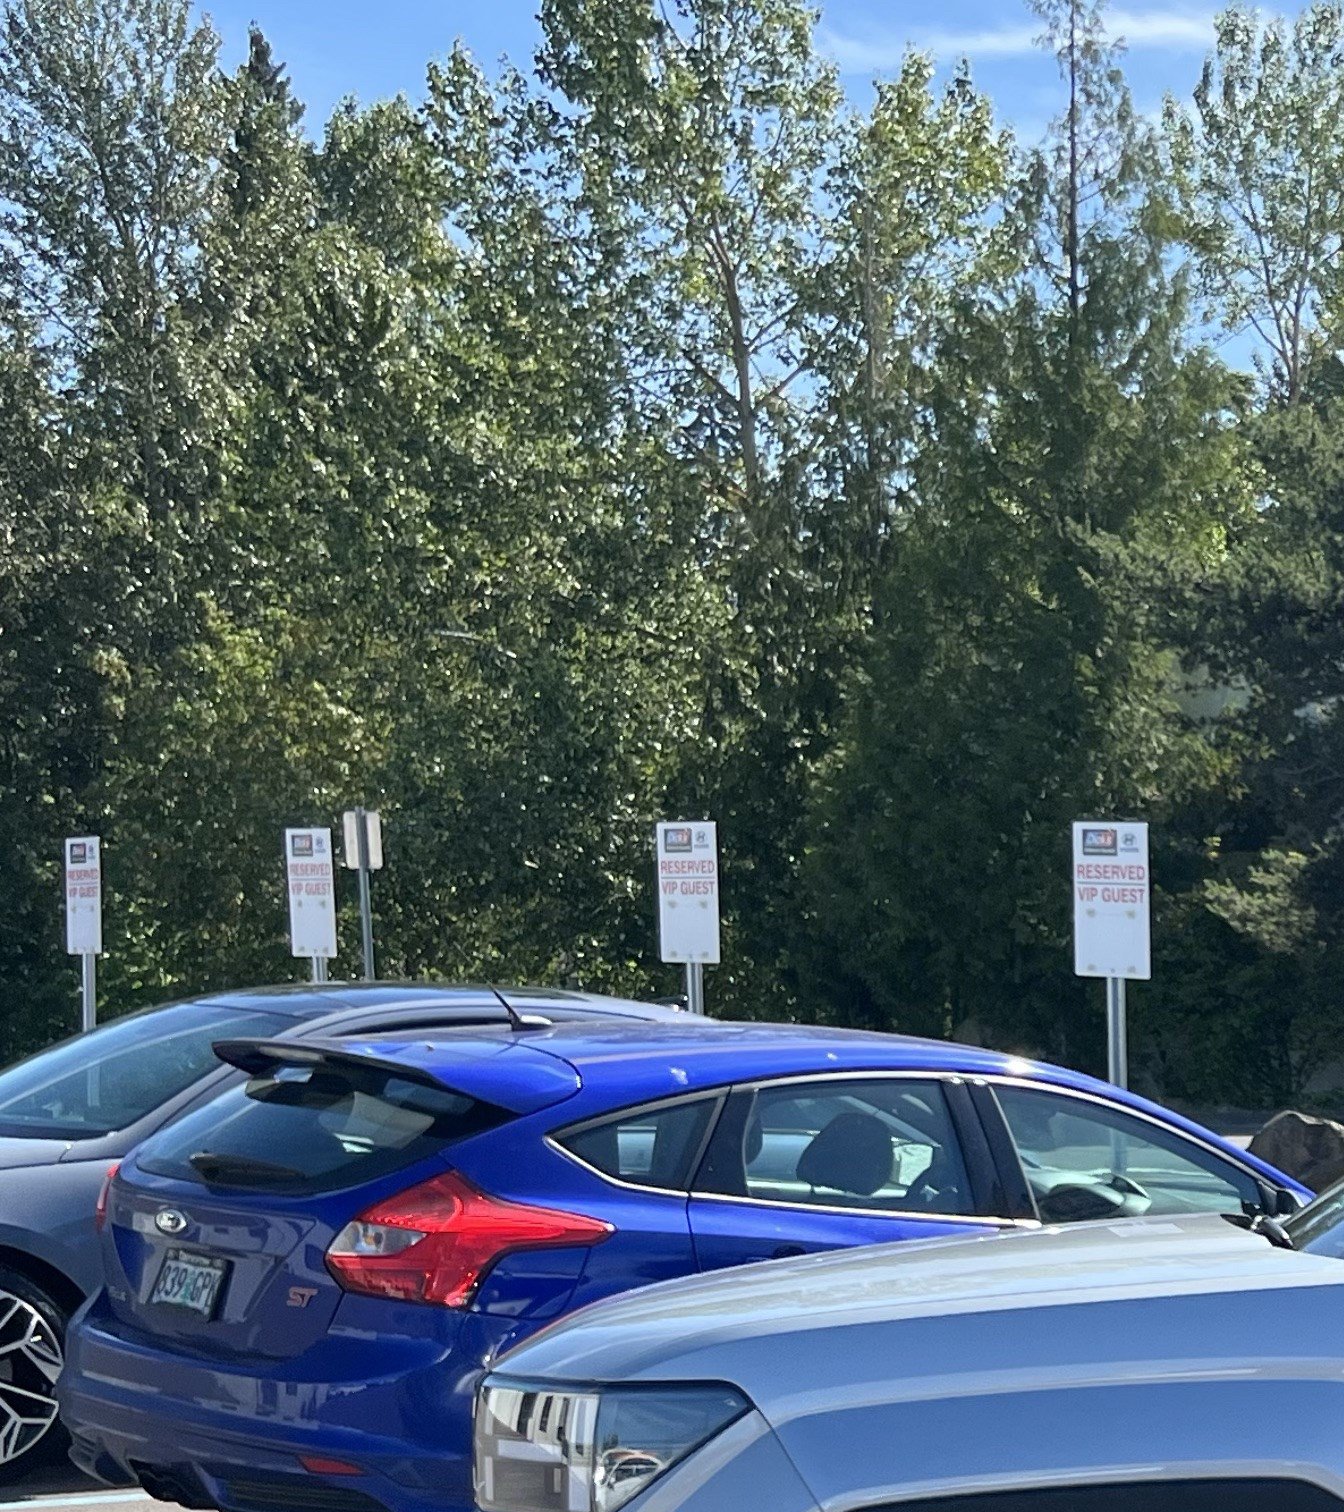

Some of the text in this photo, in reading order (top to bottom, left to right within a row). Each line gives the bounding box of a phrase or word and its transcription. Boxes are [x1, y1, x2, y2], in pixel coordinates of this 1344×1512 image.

[660, 860, 715, 874] RESERVED
[1076, 864, 1145, 880] RESERVED
[662, 881, 715, 895] VIP GUEST
[1078, 887, 1145, 903] VIP GUEST
[286, 1286, 318, 1308] ST
